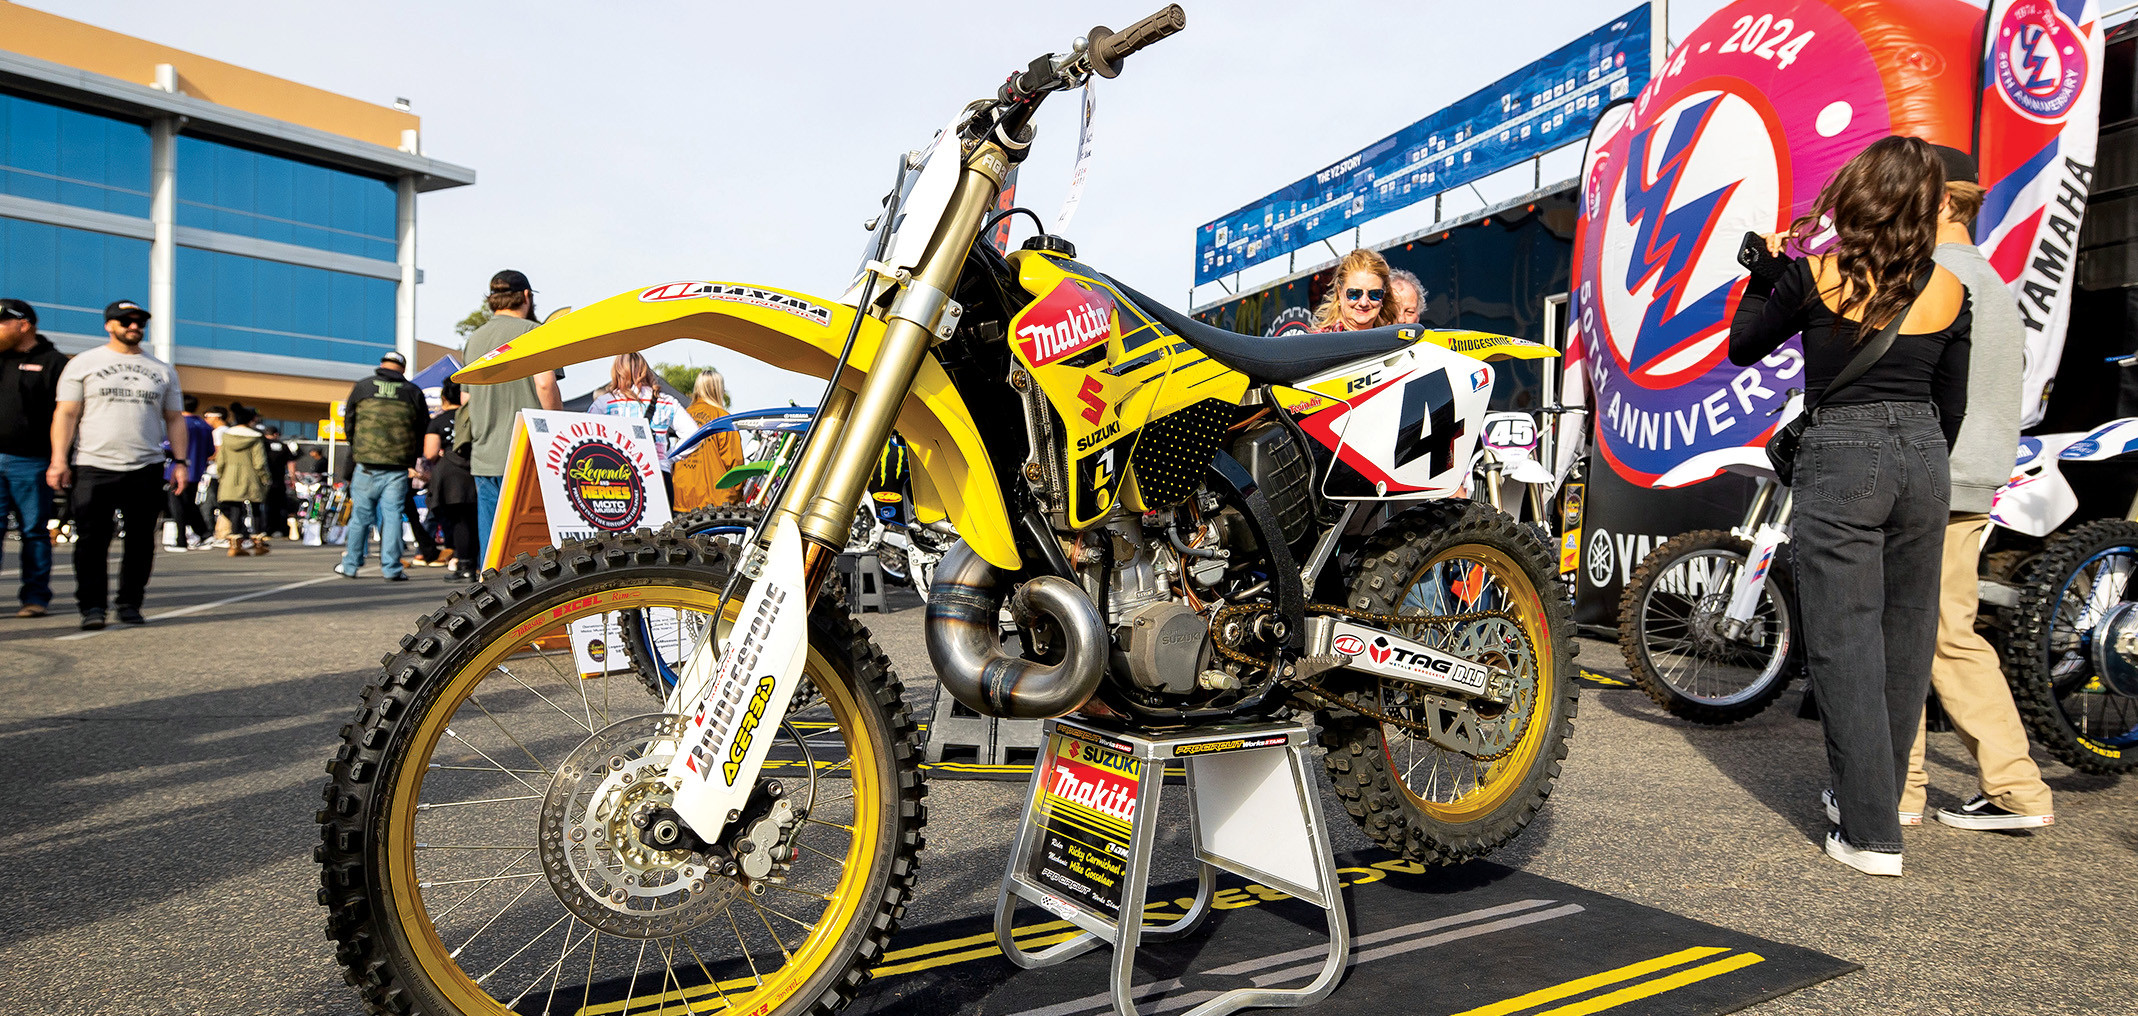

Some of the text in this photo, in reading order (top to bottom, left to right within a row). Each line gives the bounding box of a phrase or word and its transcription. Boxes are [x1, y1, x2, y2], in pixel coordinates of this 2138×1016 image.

[1718, 13, 1816, 70] 2024
[1316, 153, 1363, 184] THE YZ STORY
[2018, 156, 2095, 332] YAMAHA
[1448, 337, 1512, 352] BRIDGESTONE
[1580, 280, 1806, 451] 50TH ANNIVERS
[1347, 370, 1383, 394] RC
[1288, 395, 1323, 416] Twin Air
[1076, 420, 1121, 452] SUZUKI
[1394, 367, 1466, 481] 4
[1488, 420, 1534, 446] 45
[546, 421, 655, 478] JOIN OUR TEAM
[569, 458, 632, 485] Legends
[580, 485, 632, 500] HEROES
[592, 500, 626, 508] MOTO
[553, 595, 603, 619] EXCEL
[612, 591, 630, 601] Rim
[1162, 632, 1201, 646] SUZUKI
[1391, 647, 1453, 674] TAG
[690, 582, 788, 783] BRIDGESTONE
[722, 674, 776, 788] ACERBIS
[1242, 740, 1265, 749] Works
[1083, 745, 1141, 776] SUZUKI
[1068, 844, 1086, 862] Ricky
[1085, 852, 1122, 875] Carmichael
[1041, 867, 1061, 882] PRO
[1059, 875, 1092, 895] CIRCUIT
[1068, 860, 1085, 875] Mike
[1084, 867, 1115, 888] Gosselaar
